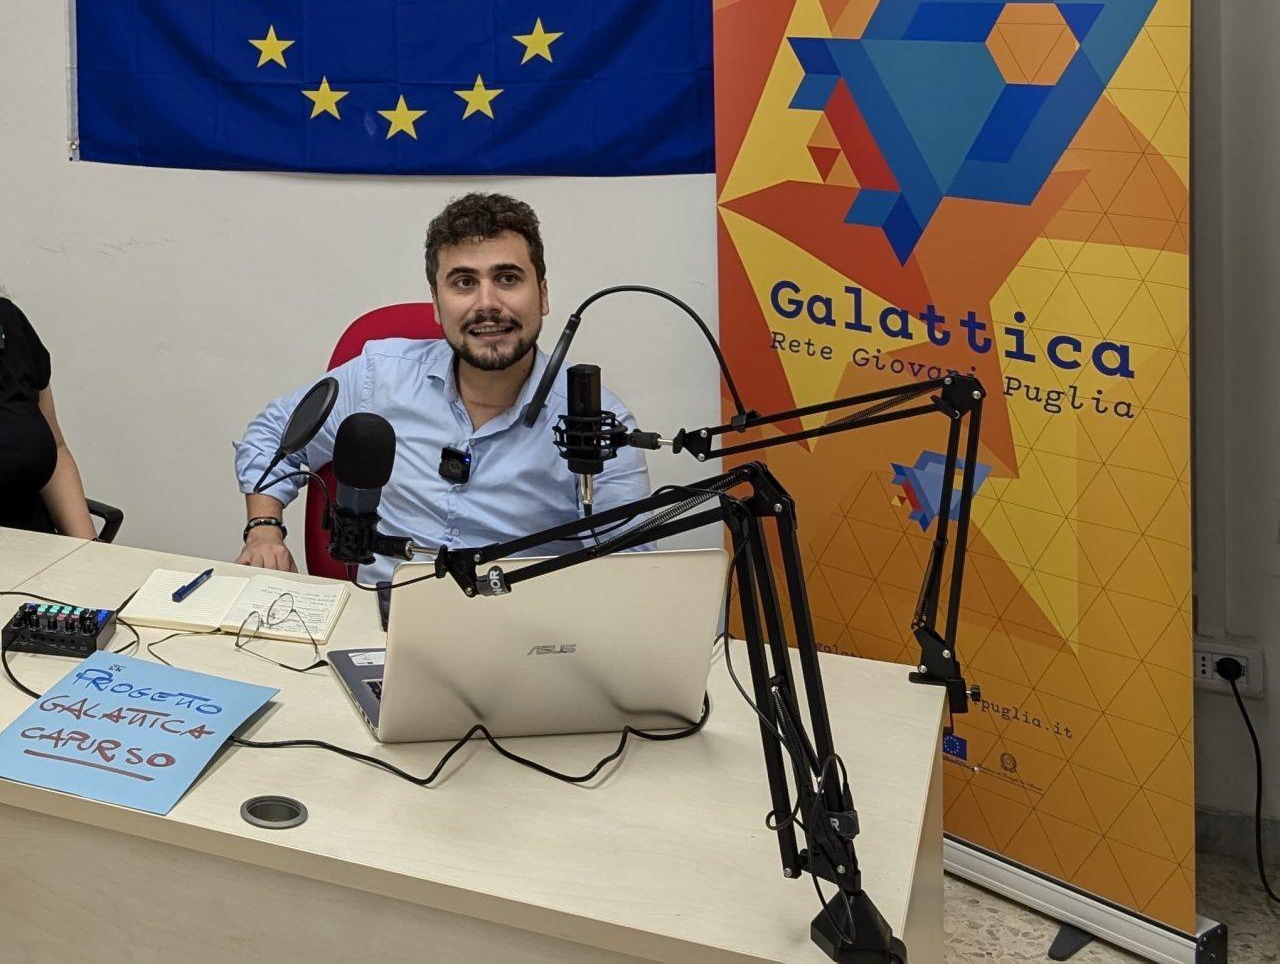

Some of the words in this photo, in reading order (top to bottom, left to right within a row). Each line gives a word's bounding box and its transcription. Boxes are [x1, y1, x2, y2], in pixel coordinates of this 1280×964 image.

[770, 280, 1135, 378] Galattica
[770, 332, 834, 360] Rete
[1003, 376, 1135, 420] Puglia
[526, 644, 577, 656] ASUS
[72, 668, 223, 715] PROGETTO
[20, 726, 177, 768] CAPURSO
